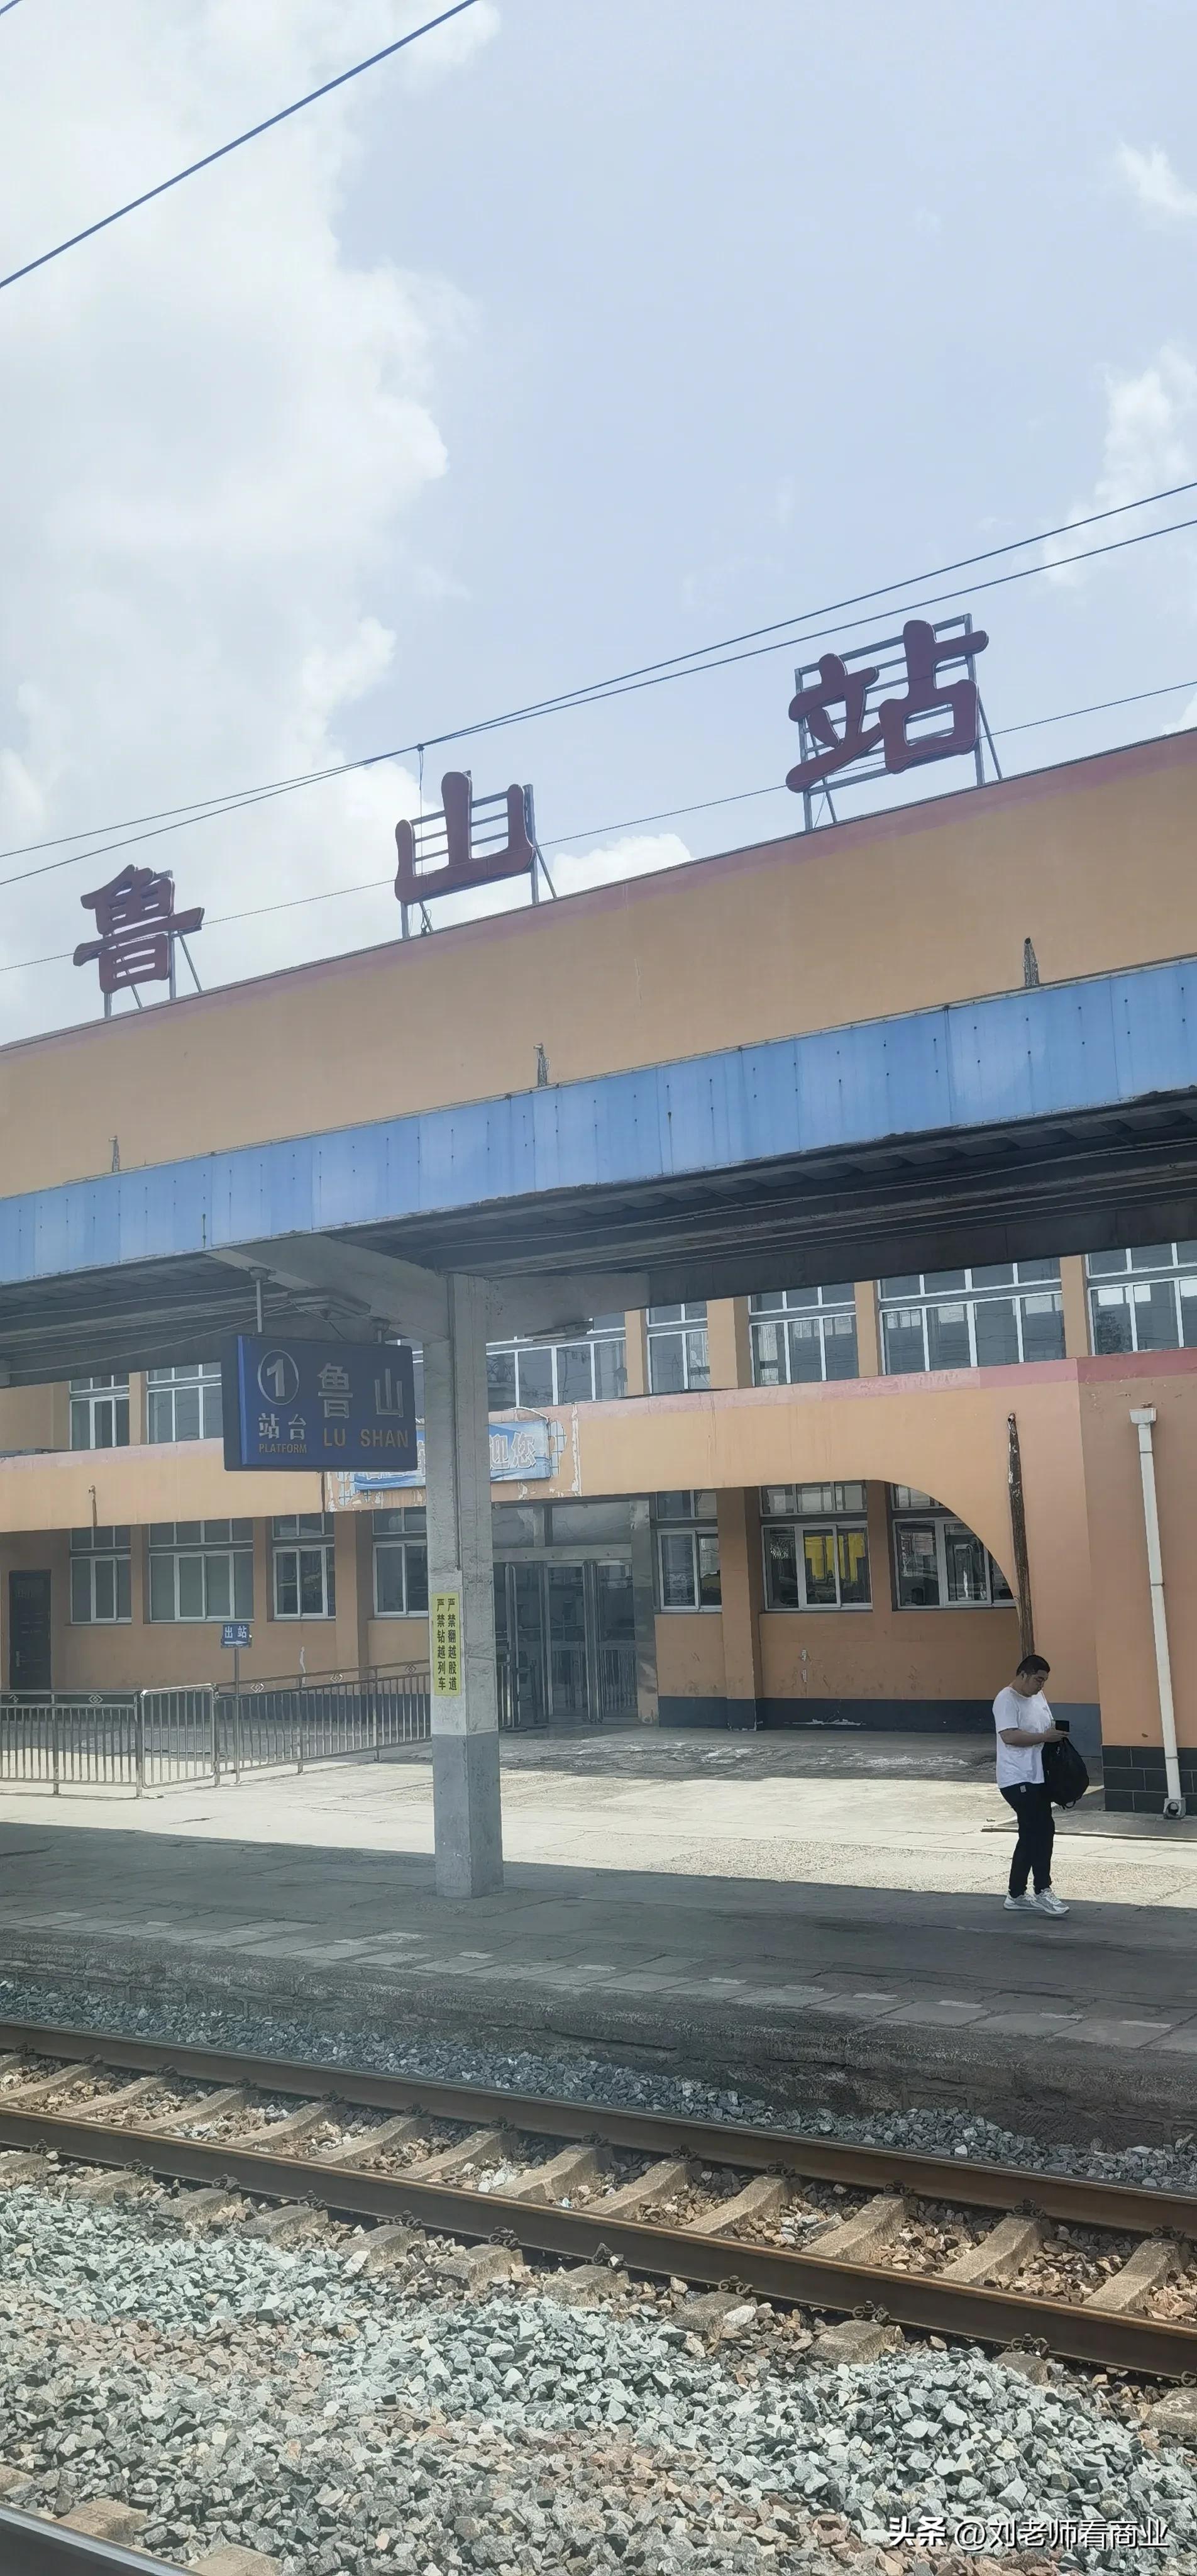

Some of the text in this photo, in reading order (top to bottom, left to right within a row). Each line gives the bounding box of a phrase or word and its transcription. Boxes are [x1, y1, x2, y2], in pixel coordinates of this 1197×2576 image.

[73, 619, 989, 993] 鲁山站
[317, 1362, 404, 1419] 鲁山
[258, 1413, 307, 1440] 站台
[324, 1428, 409, 1448] LU SHAN
[259, 1443, 307, 1453] PLATFORM
[224, 1625, 247, 1638] 出站
[436, 1597, 446, 1691] 严禁钻越列车
[447, 1597, 458, 1691] 严禁翻越股道
